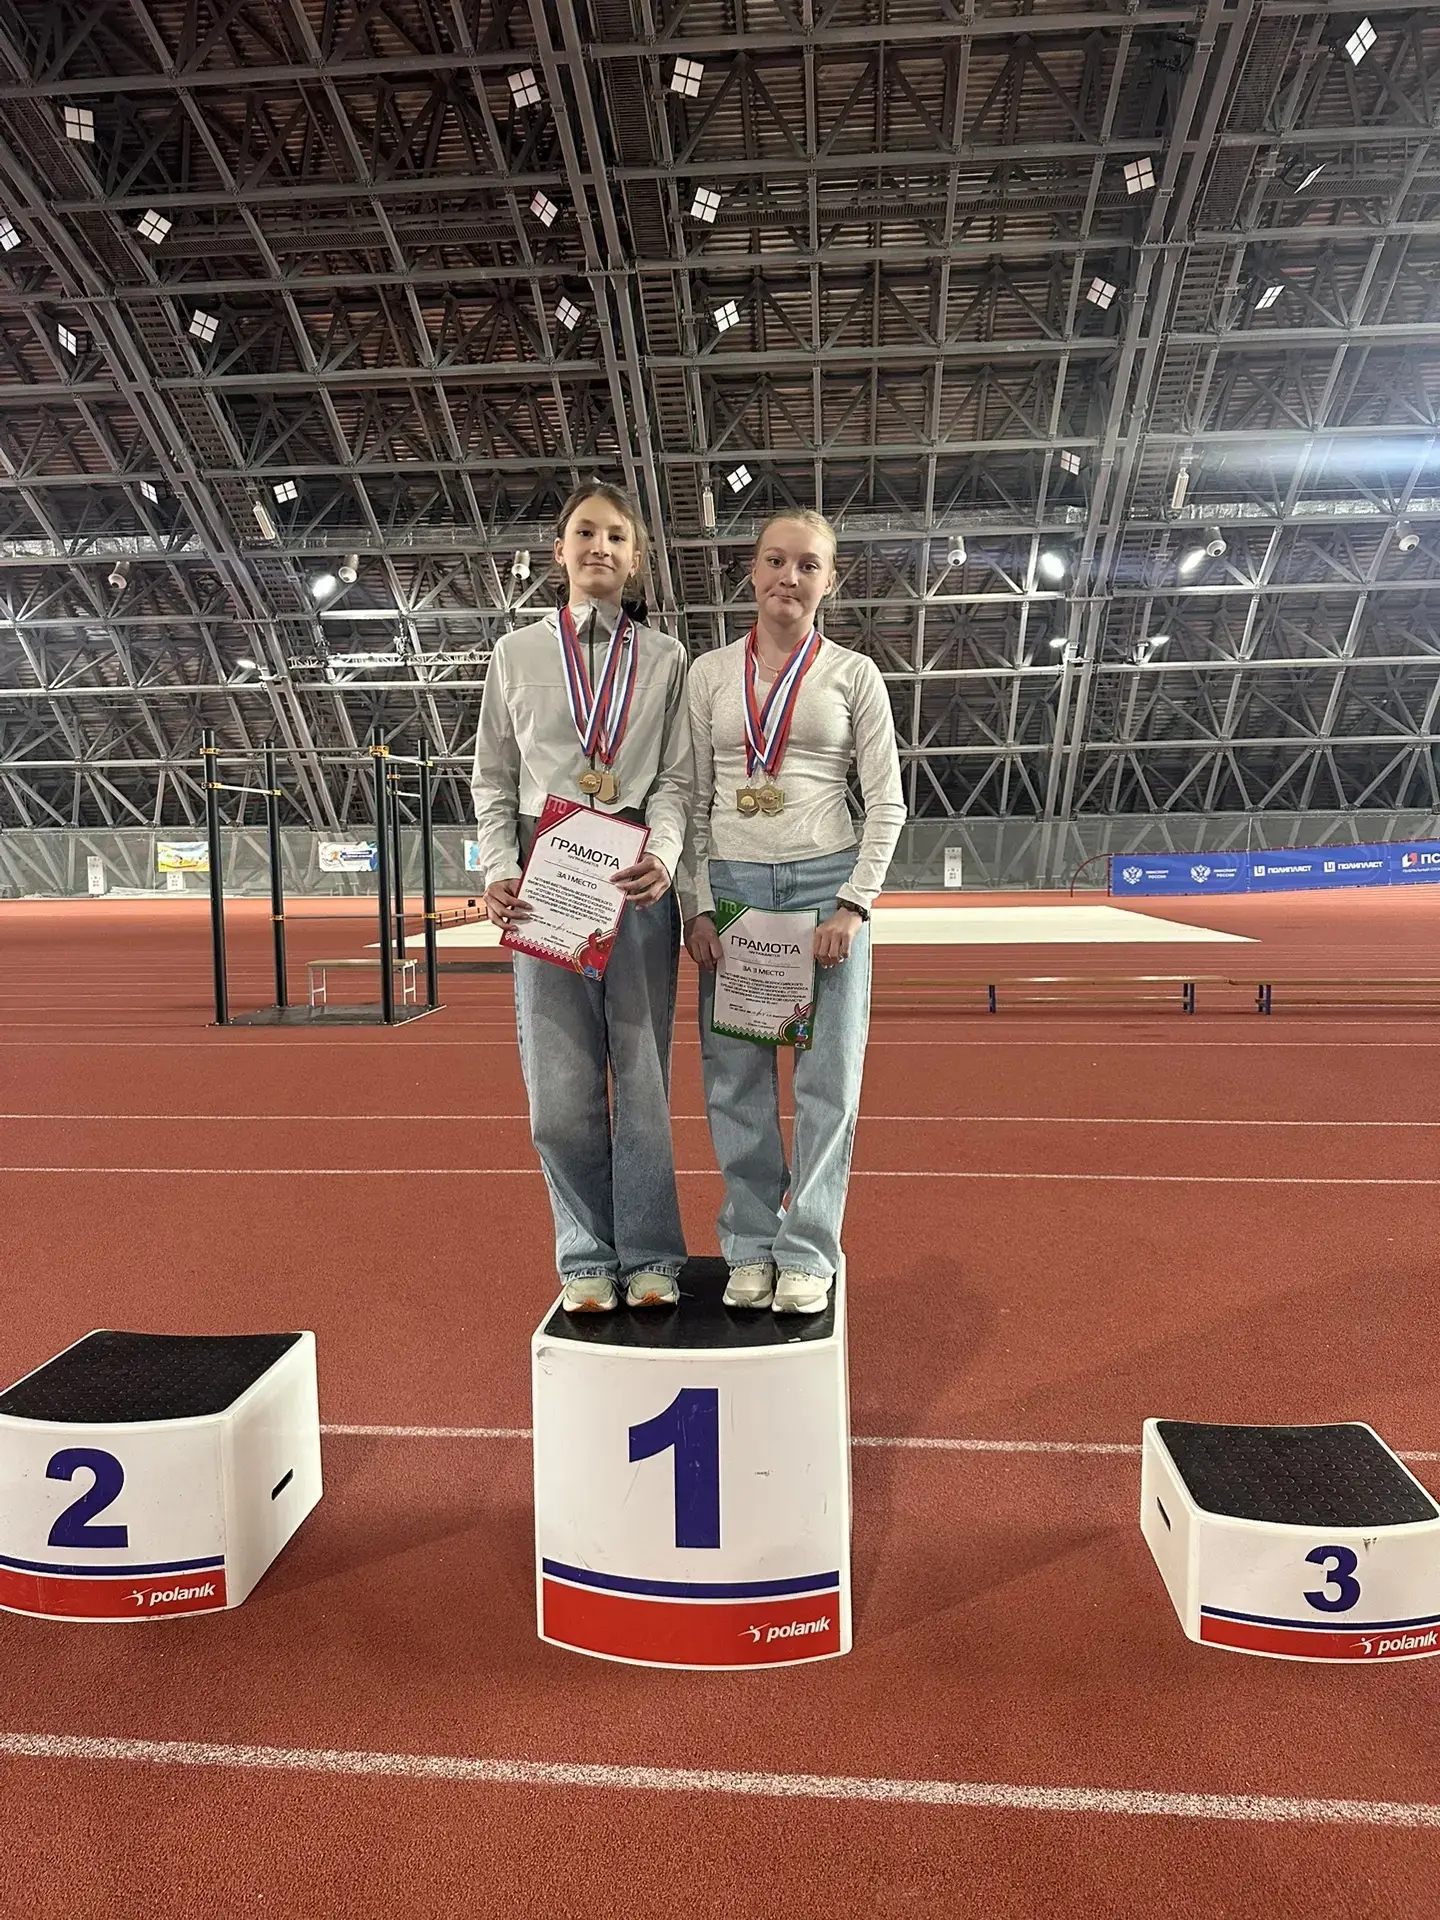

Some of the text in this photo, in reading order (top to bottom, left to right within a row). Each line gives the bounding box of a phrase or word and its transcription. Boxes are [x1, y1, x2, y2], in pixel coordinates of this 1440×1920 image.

[550, 836, 620, 870] ГРАМОТА
[1338, 861, 1383, 870] ПОЛИПЛАСТ
[556, 871, 567, 880] ЗА
[571, 876, 597, 890] МЕСТО
[1268, 865, 1312, 874] ПОЛИПЛАСТ
[731, 935, 801, 954] ГРАМОТА
[743, 965, 752, 973] ЗА
[758, 968, 785, 977] МЕСТО
[628, 1387, 721, 1549] 1
[45, 1447, 129, 1548] 2
[1303, 1545, 1361, 1613] 3
[149, 1581, 216, 1607] polanik
[765, 1615, 832, 1643] polanik
[1377, 1630, 1439, 1656] polanik
